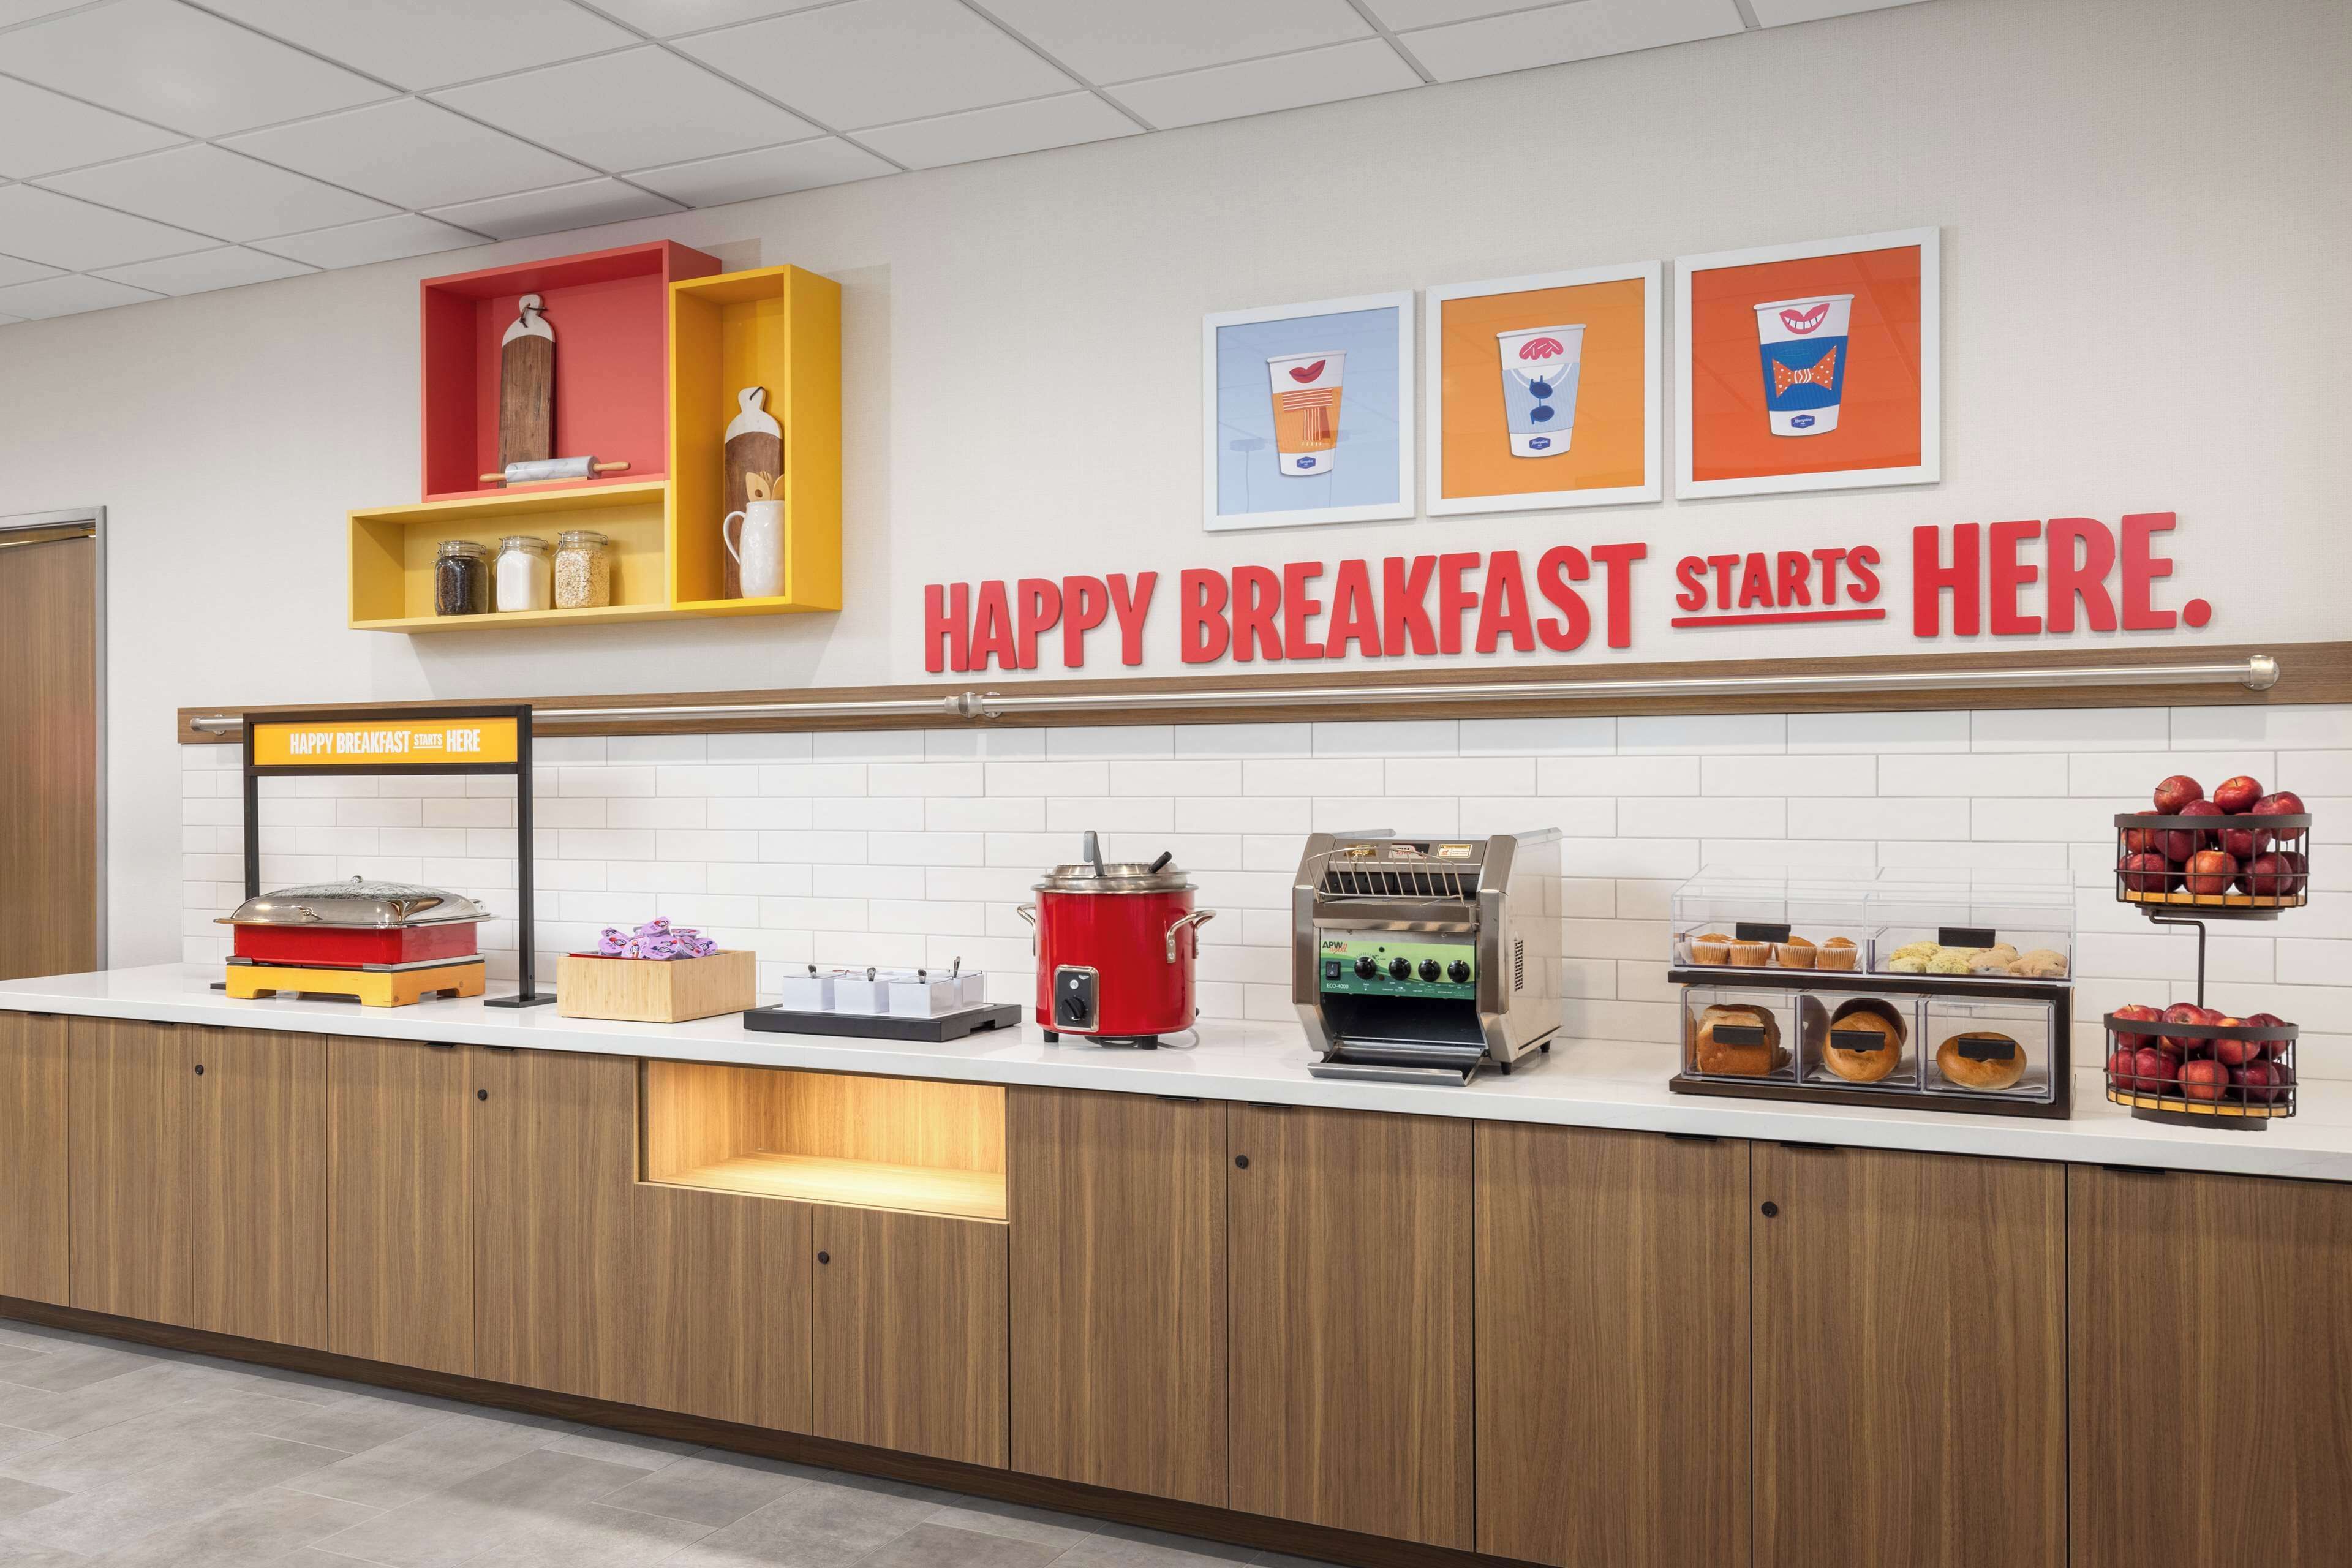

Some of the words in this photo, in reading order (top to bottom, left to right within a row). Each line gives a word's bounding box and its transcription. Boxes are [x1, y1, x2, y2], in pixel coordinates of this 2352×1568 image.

[925, 572, 1157, 673] HAPPY
[1182, 543, 1646, 663] BREAKFAST
[1676, 546, 1880, 611] STARTS
[1913, 513, 2211, 636] HERE.
[290, 733, 333, 754] HAPPY
[336, 731, 411, 753] BREAKFAST
[413, 734, 442, 746] STARTS
[447, 729, 480, 752] HERE
